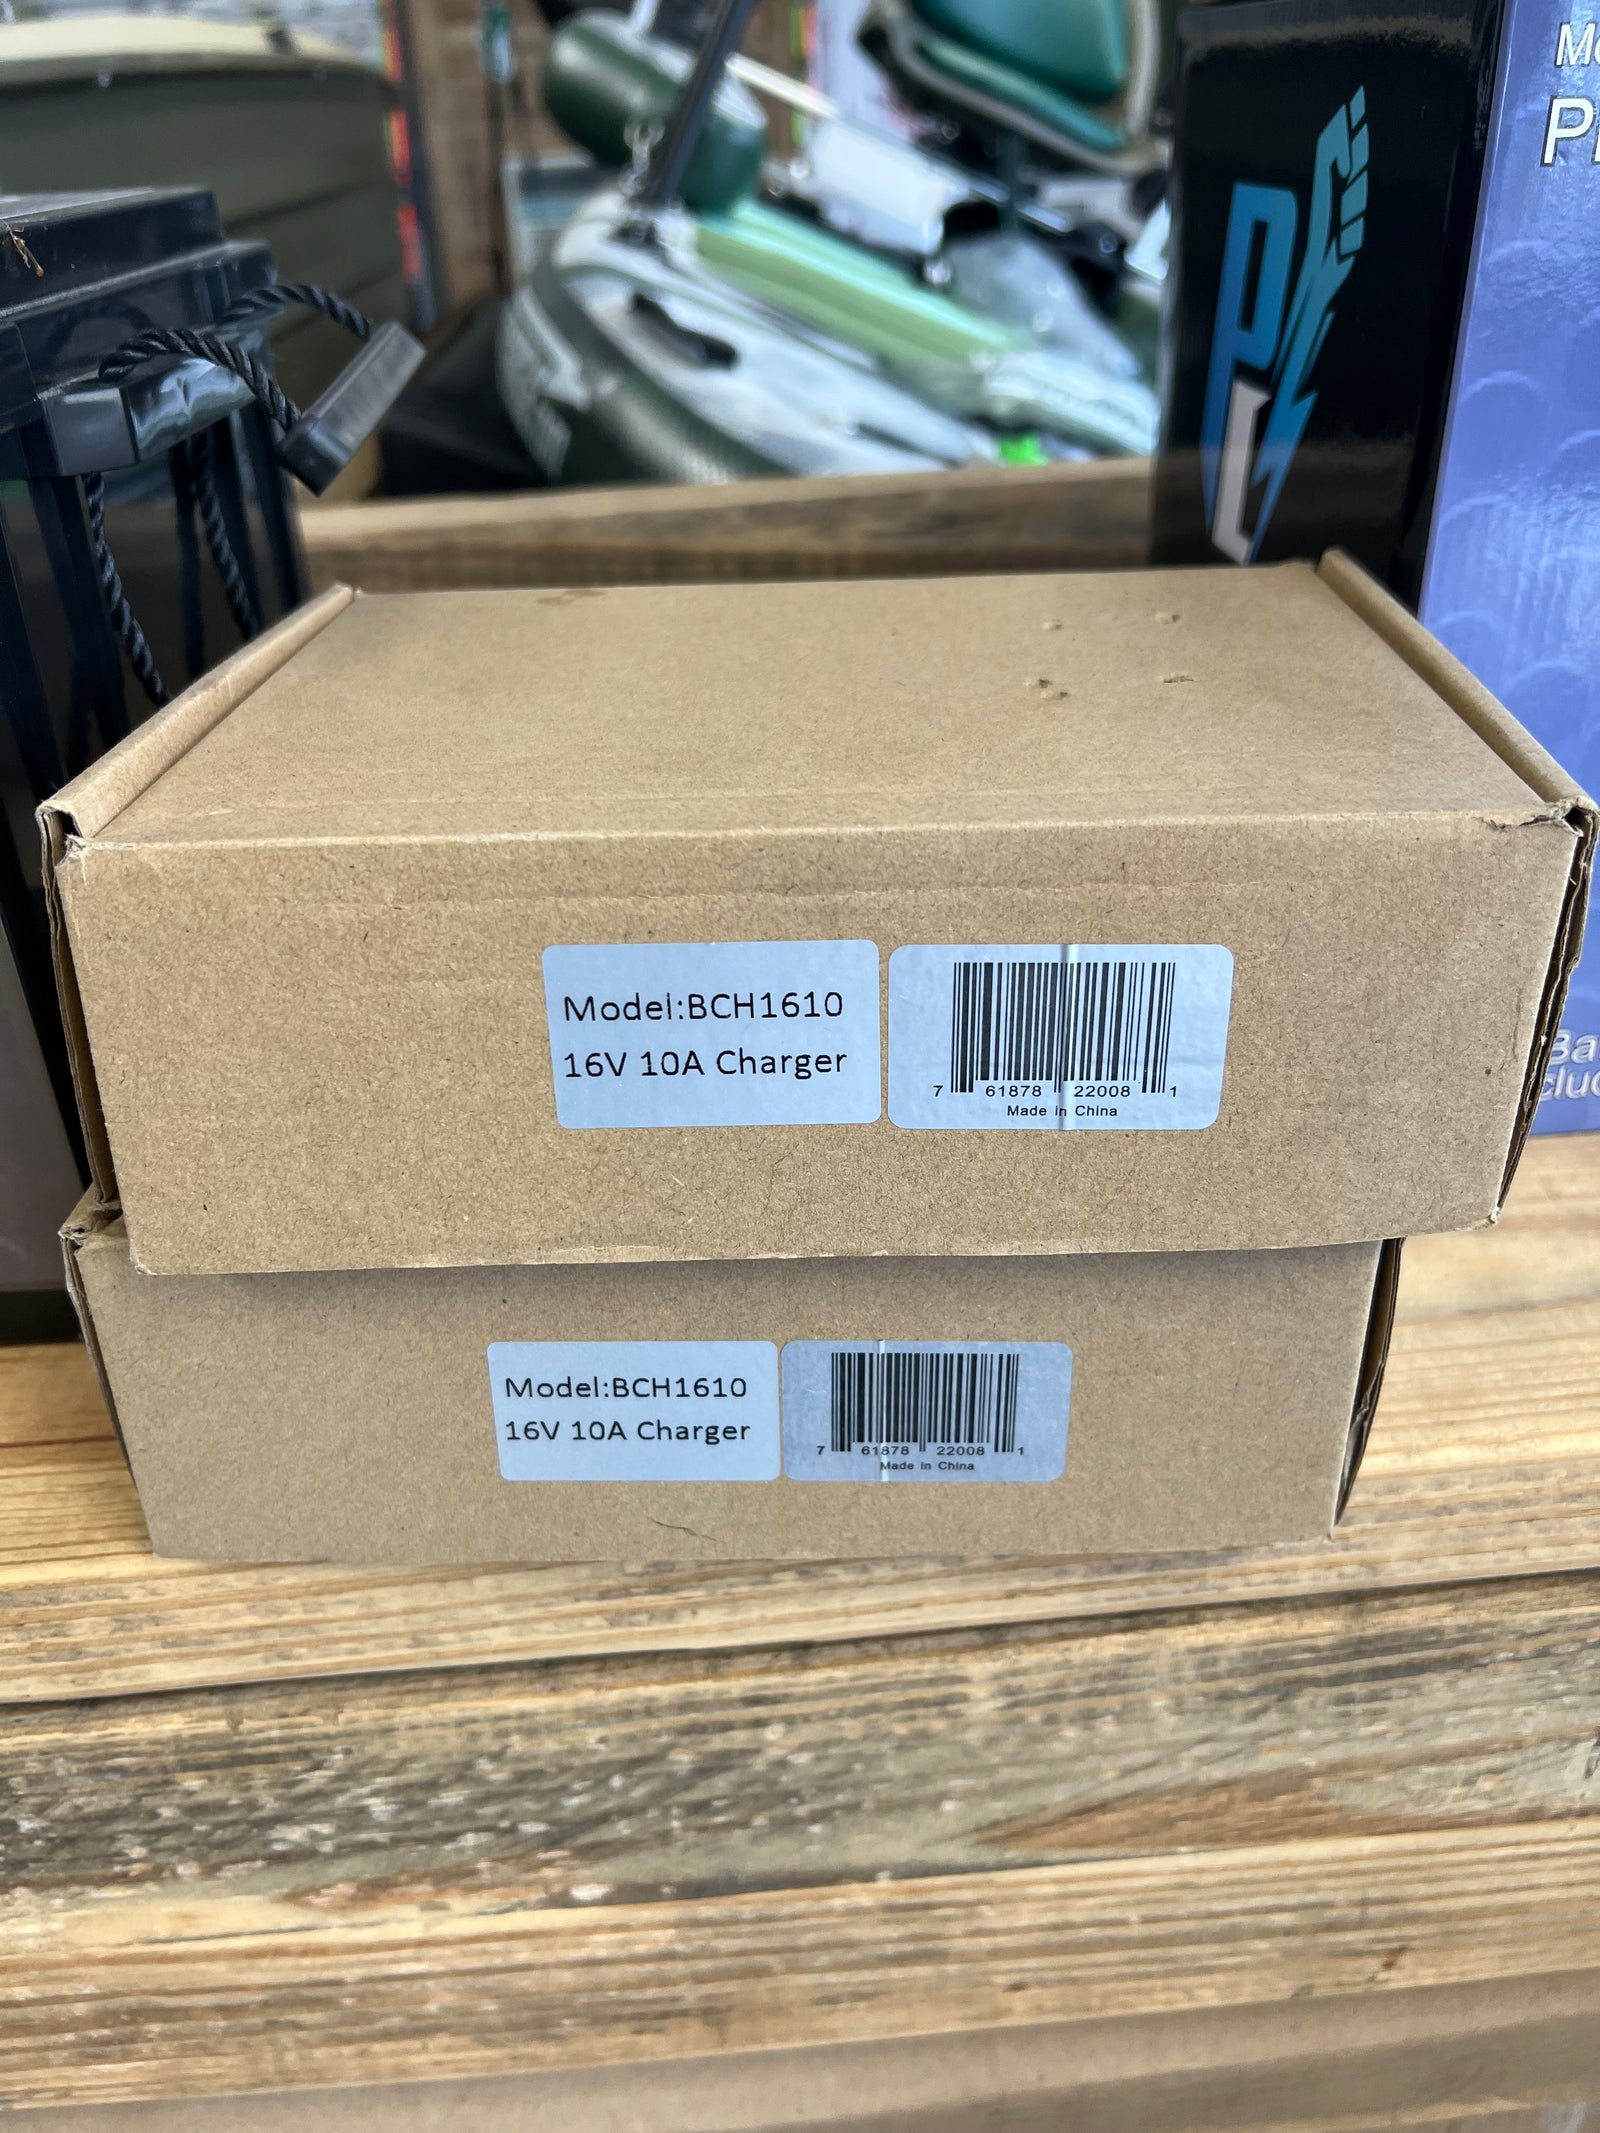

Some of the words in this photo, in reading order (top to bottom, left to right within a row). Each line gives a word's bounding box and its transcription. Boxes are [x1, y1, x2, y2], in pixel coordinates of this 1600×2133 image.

[1555, 22, 1600, 68] M
[564, 991, 844, 1022] Model:BCH1610
[1551, 1030, 1600, 1066] Ba
[564, 1052, 627, 1077] 16V
[640, 1050, 705, 1076] 10A
[716, 1047, 848, 1080] Charger
[932, 1086, 943, 1097] 7
[985, 1086, 1042, 1098] 61878
[1074, 1086, 1131, 1098] 22008
[1170, 1087, 1178, 1097] 1
[1006, 1105, 1048, 1117] Made
[1054, 1105, 1067, 1117] in
[1075, 1105, 1118, 1117] China
[505, 1376, 747, 1398] Model:BCH1610
[505, 1421, 560, 1441] 16V
[571, 1421, 628, 1441] 10A
[637, 1419, 751, 1445] Charger
[816, 1446, 826, 1456] 7
[861, 1446, 910, 1456] 61878
[936, 1446, 985, 1456] 22008
[1017, 1446, 1025, 1456] 1
[880, 1461, 914, 1470] Made
[920, 1460, 932, 1470] in
[938, 1461, 975, 1471] China
